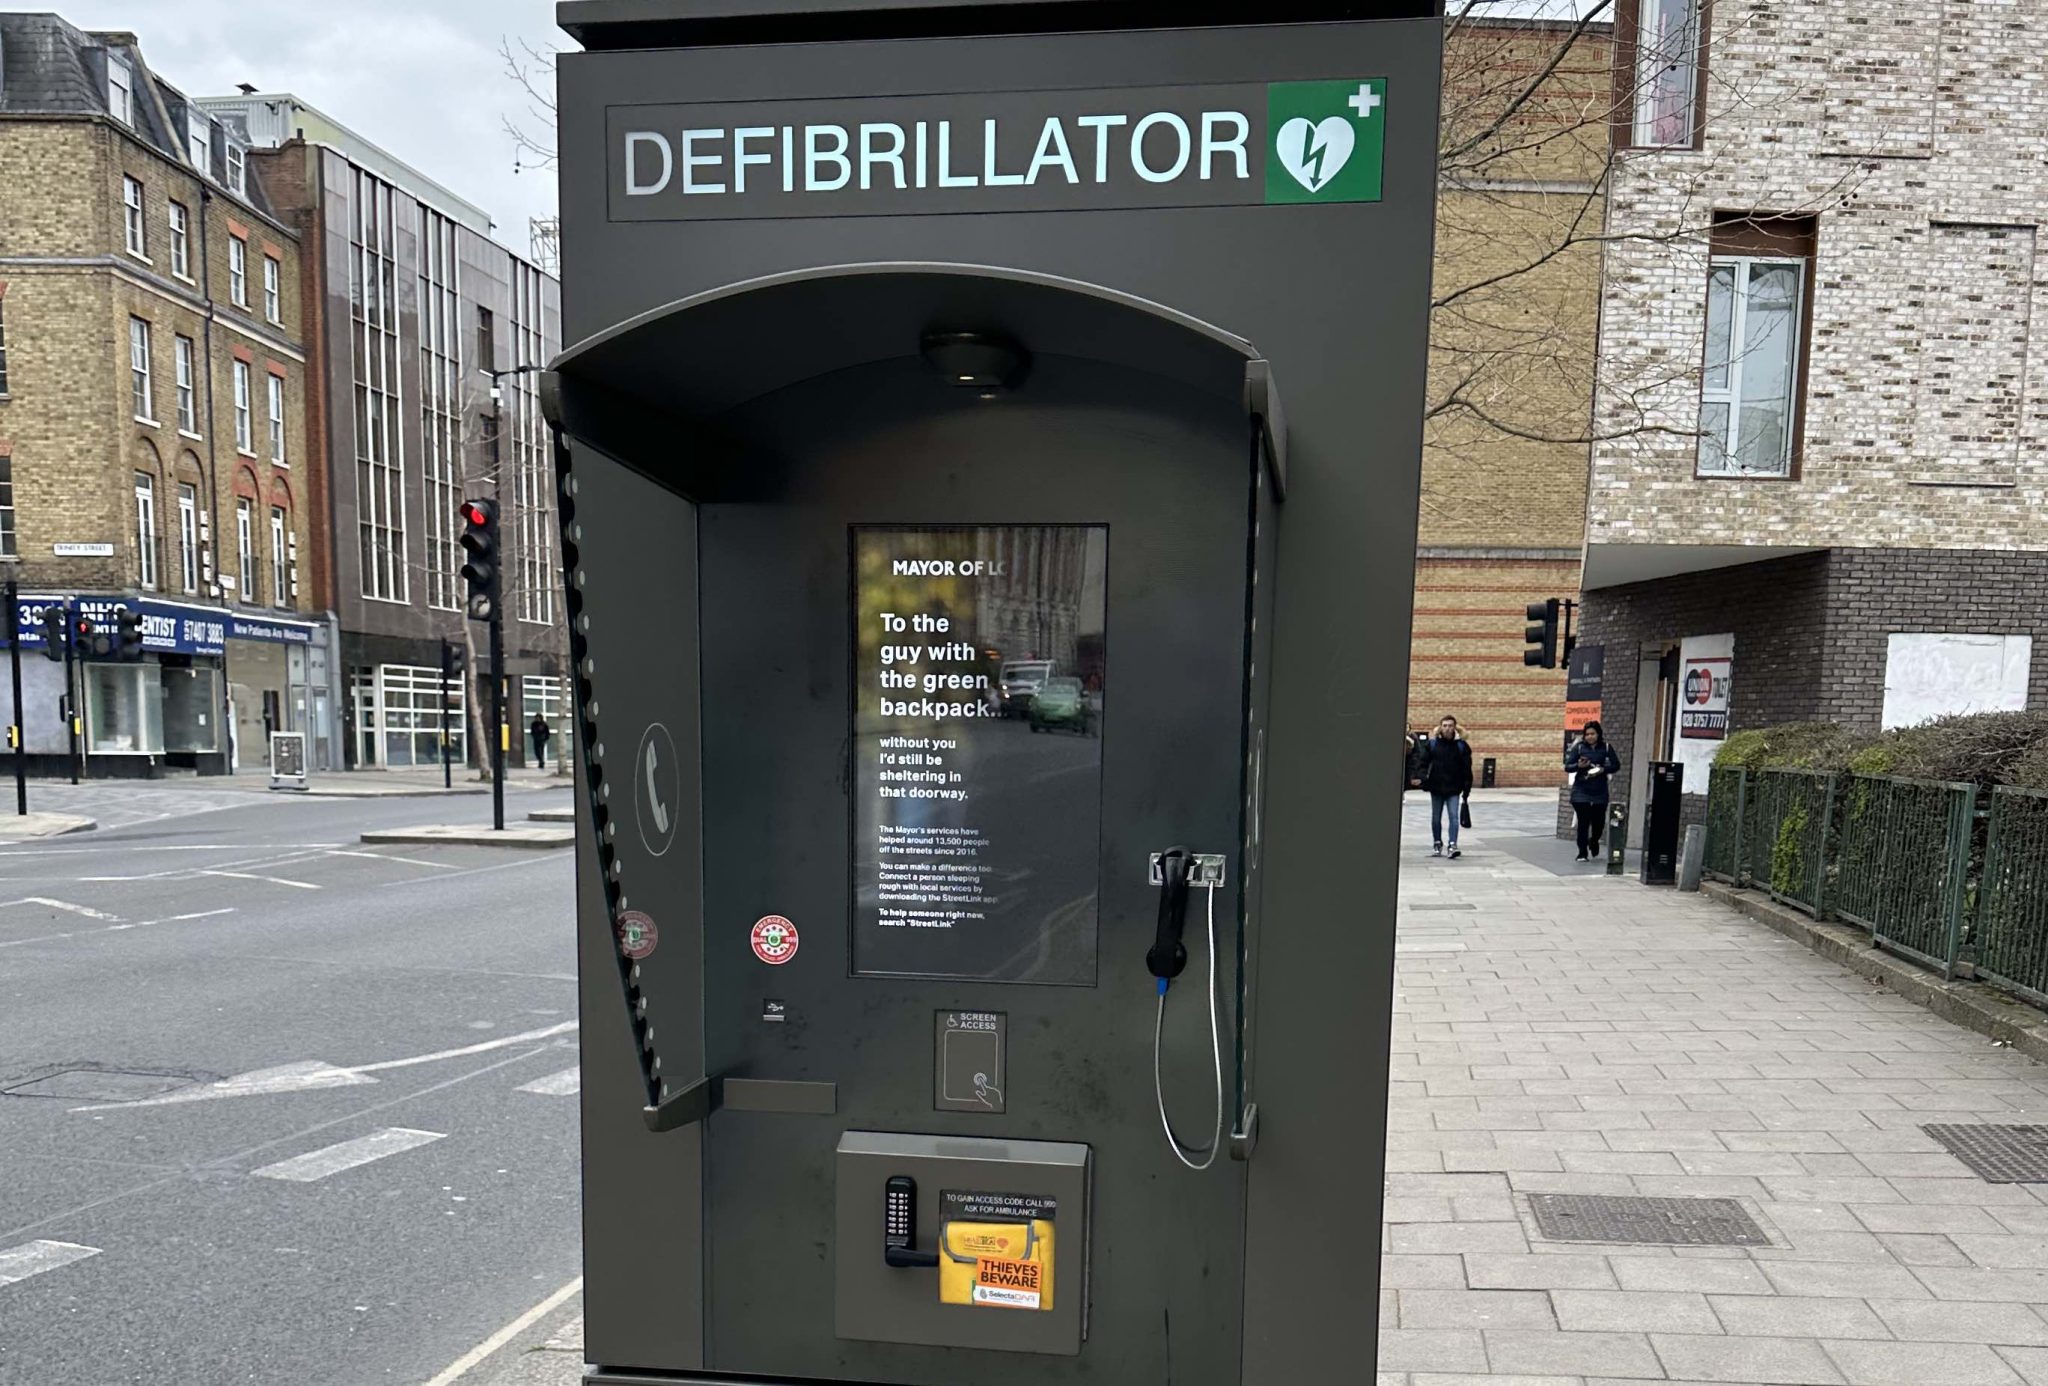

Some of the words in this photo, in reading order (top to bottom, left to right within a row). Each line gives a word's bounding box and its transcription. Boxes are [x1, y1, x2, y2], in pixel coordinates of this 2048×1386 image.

[624, 110, 1250, 196] DEFIBRILLATOR
[892, 560, 956, 577] MAYOR
[959, 560, 984, 576] OF
[134, 614, 177, 637] ENTIST
[880, 613, 906, 632] To
[912, 614, 949, 632] the
[880, 645, 922, 665] guy
[928, 642, 975, 661] with
[880, 670, 917, 689] the
[923, 674, 989, 693] green
[880, 698, 1008, 720] backpack...
[880, 737, 930, 748] without
[932, 739, 956, 750] you
[880, 753, 895, 764] I'd
[898, 753, 922, 765] still
[926, 754, 942, 765] be
[880, 770, 946, 784] sheltering
[949, 771, 961, 782] in
[879, 786, 906, 797] that
[909, 787, 968, 801] doorway.
[879, 825, 893, 833] The
[895, 826, 925, 835] Mayor's
[926, 827, 959, 835] services
[960, 827, 979, 835] have
[879, 836, 905, 845] helped
[935, 837, 961, 846] 13,500
[962, 838, 990, 847] people
[905, 847, 933, 855] streets
[879, 862, 893, 870] You
[909, 863, 930, 871] make
[938, 864, 977, 872] difference
[879, 872, 911, 880] Connect
[919, 875, 946, 883] person
[947, 874, 980, 884] sleeping
[879, 883, 901, 892] rough
[902, 883, 919, 891] with
[920, 883, 938, 891] local
[939, 885, 972, 893] services
[973, 885, 983, 894] by
[879, 893, 927, 902] downloading
[928, 894, 941, 902] the
[942, 894, 982, 903] StreetLink
[879, 908, 889, 916] To
[889, 908, 907, 918] help
[908, 910, 945, 918] someone
[945, 910, 965, 920] right
[967, 912, 986, 920] now,
[960, 1013, 997, 1022] SCREEN
[960, 1021, 996, 1030] ACCESS
[946, 1193, 957, 1202] TO
[957, 1194, 975, 1203] GAIN
[975, 1195, 1003, 1205] ACCESS
[1004, 1198, 1025, 1206] CODE
[1025, 1199, 1043, 1208] CALL
[964, 1204, 978, 1213] ASK
[979, 1205, 994, 1214] FOR
[994, 1206, 1038, 1217] AMBULANCE
[981, 1259, 1038, 1277] THIEVES
[980, 1271, 1038, 1289] BEWARE
